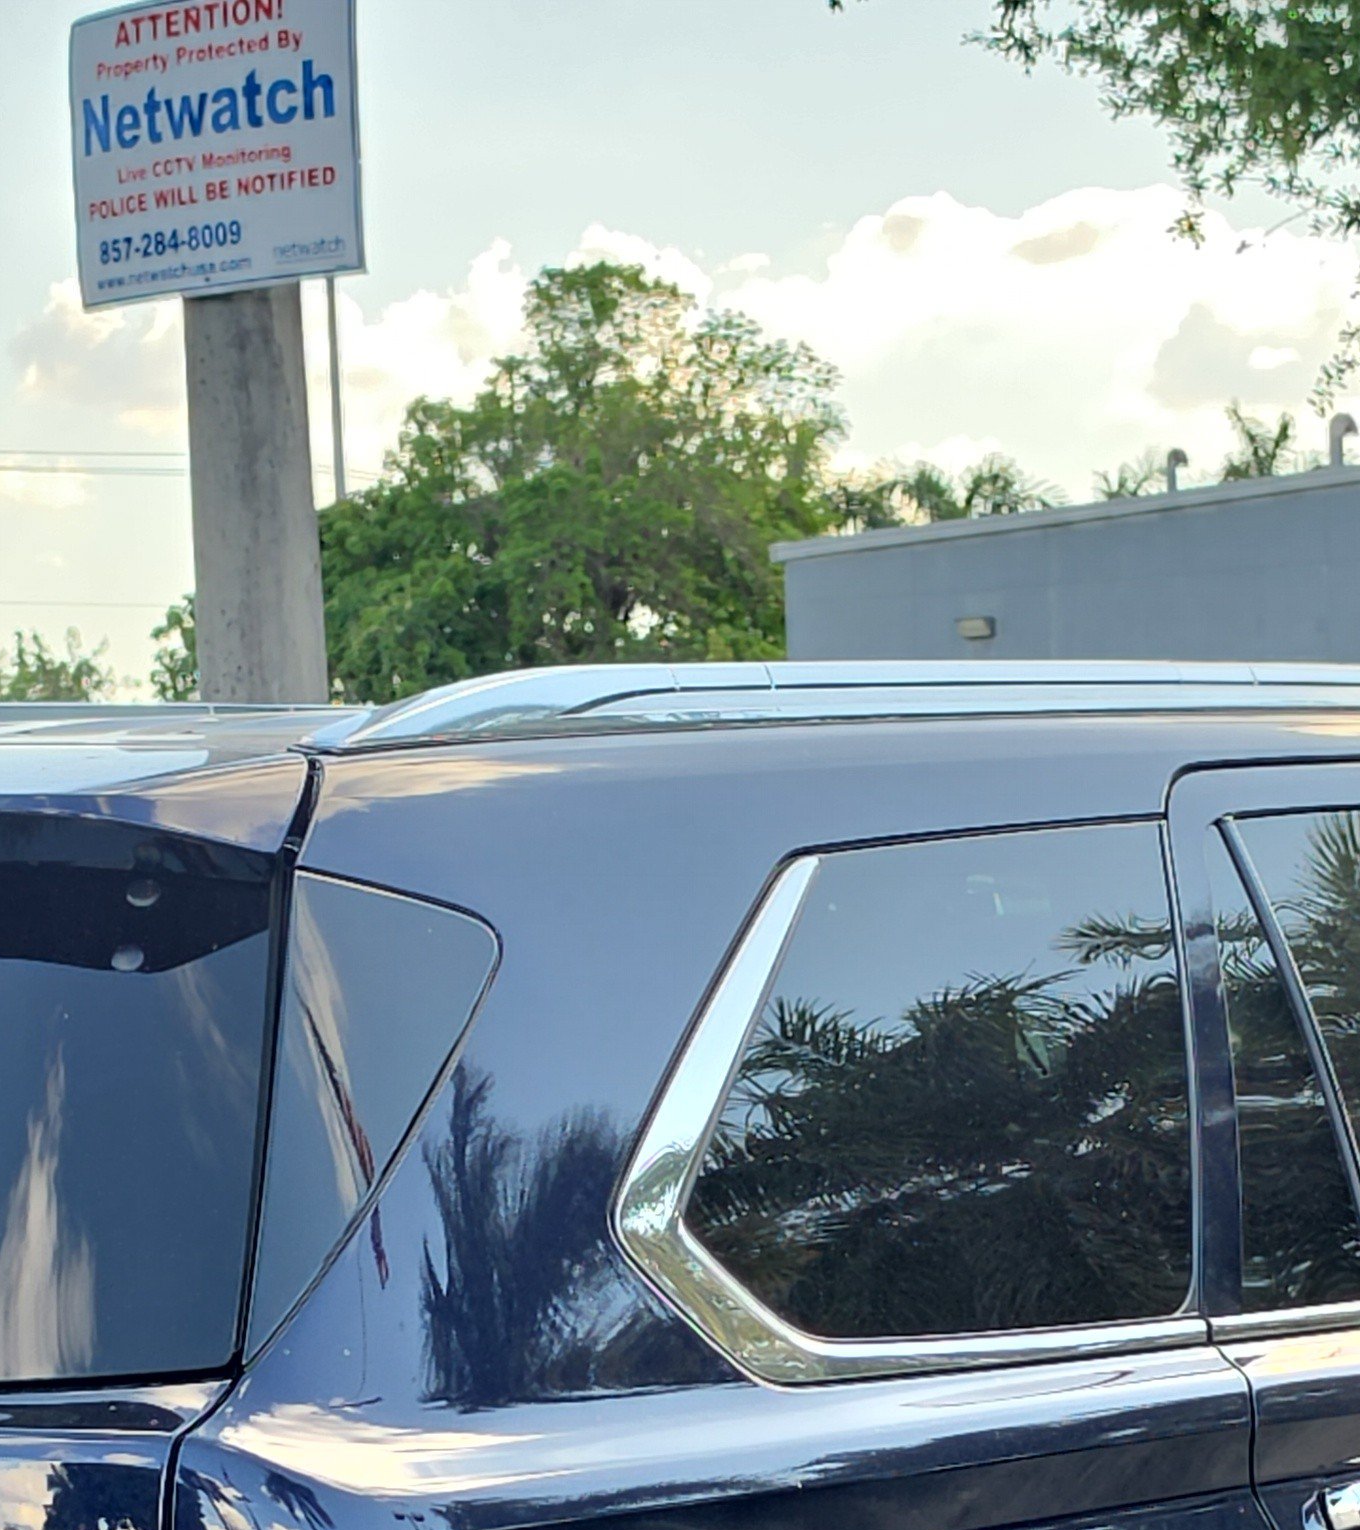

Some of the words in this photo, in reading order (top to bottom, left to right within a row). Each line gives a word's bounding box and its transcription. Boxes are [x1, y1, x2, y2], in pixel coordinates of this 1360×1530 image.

[115, 0, 284, 48] ATTENTION!
[96, 52, 168, 80] Property
[176, 36, 269, 65] Protected
[277, 29, 303, 52] By
[83, 59, 335, 157] Netwatch
[117, 166, 146, 185] Live
[153, 157, 195, 178] CCTV
[202, 145, 293, 170] Monitoring
[89, 193, 147, 222] POLICE
[154, 186, 198, 208] WILL
[205, 180, 229, 202] BE
[237, 166, 336, 197] NOTIFIED
[99, 220, 242, 266] 857-284-8009
